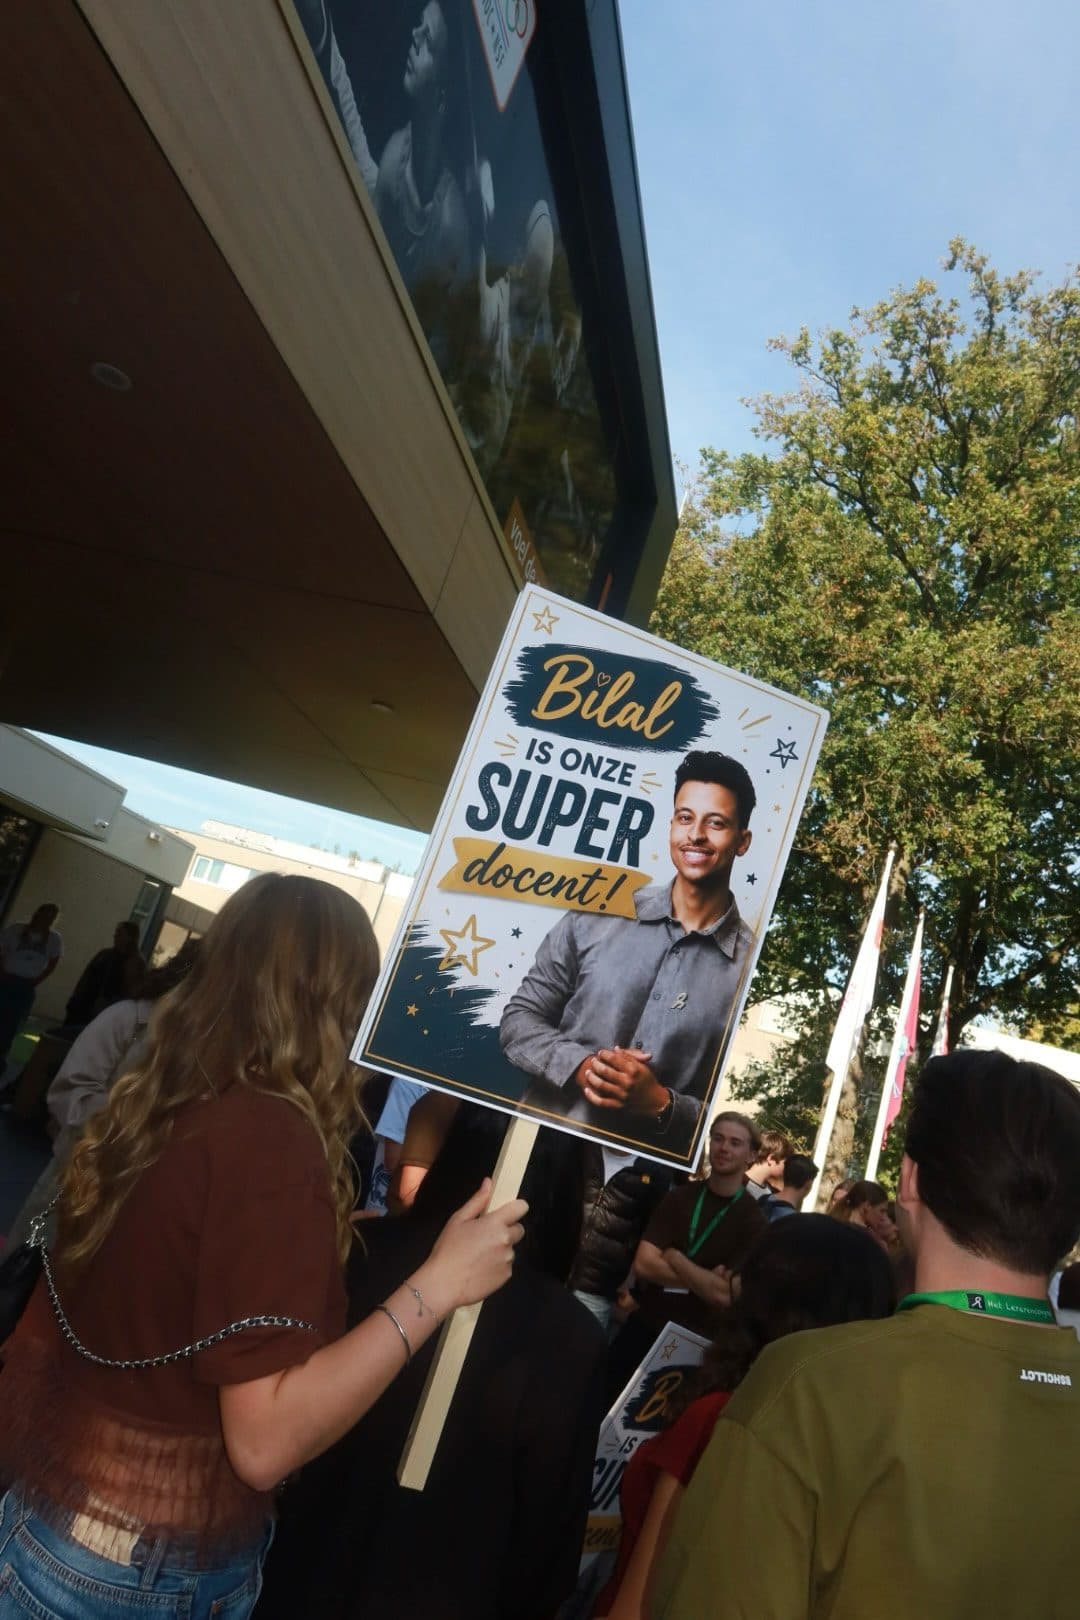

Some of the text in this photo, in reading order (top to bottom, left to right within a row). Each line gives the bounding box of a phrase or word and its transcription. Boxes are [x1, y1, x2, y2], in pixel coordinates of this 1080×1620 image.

[531, 654, 683, 740] Bilal
[525, 737, 637, 787] IS ONZE
[465, 761, 655, 868] SUPER
[463, 842, 628, 911] docent!
[619, 1435, 638, 1455] IS
